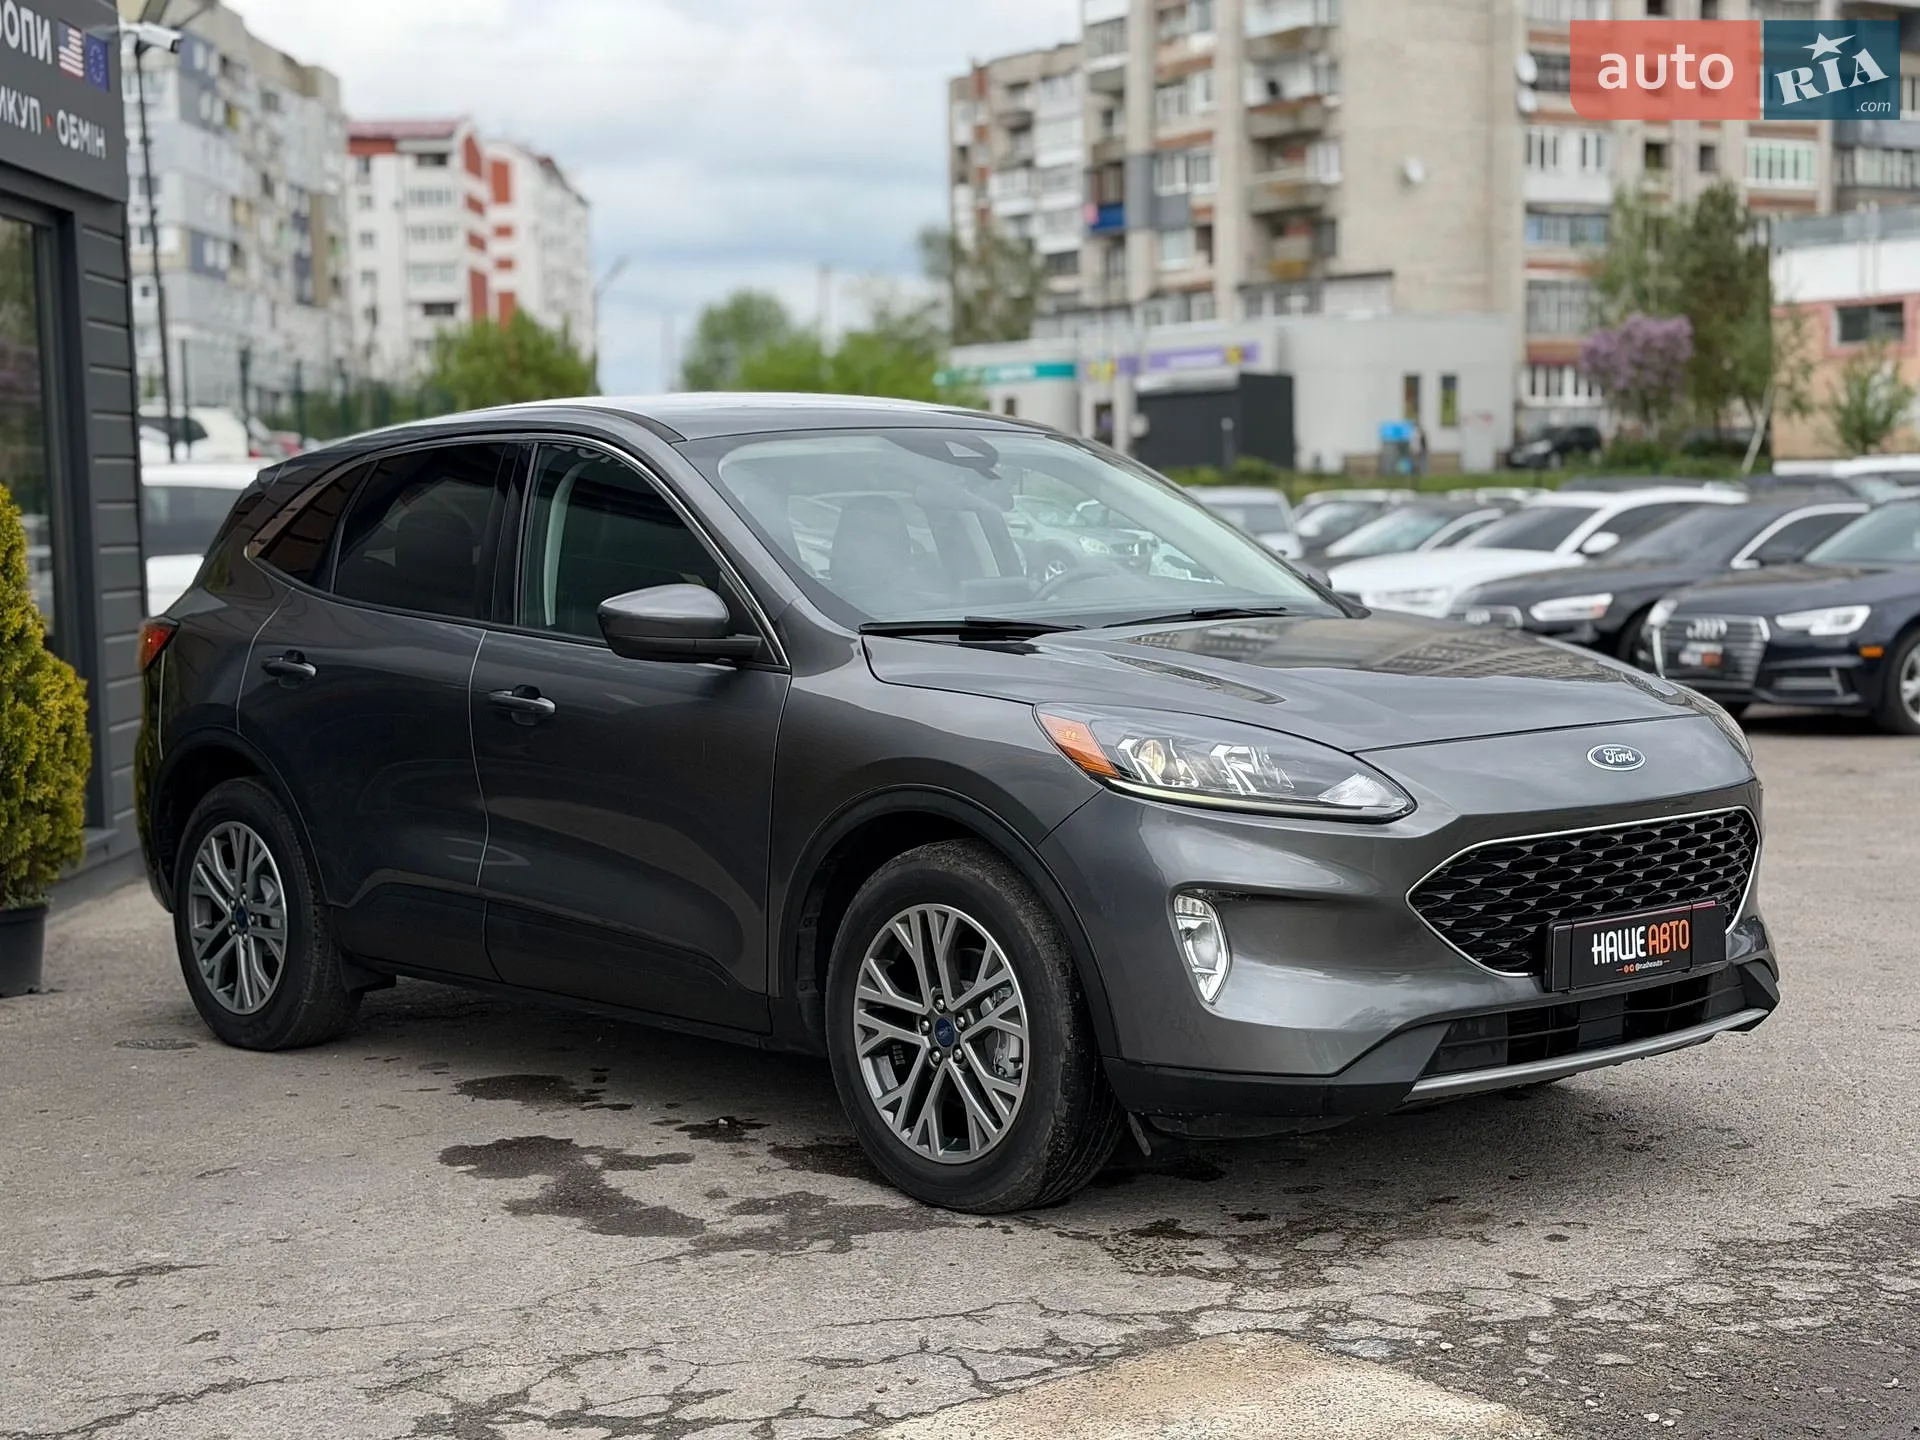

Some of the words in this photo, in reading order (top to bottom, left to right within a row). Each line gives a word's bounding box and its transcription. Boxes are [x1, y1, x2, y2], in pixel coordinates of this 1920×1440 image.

[0, 0, 52, 64] ОПИ
[57, 109, 106, 159] ОБМІН
[1603, 748, 1636, 764] Ford
[1592, 926, 1646, 965] НАШЕ
[1648, 919, 1690, 956] АВТО
